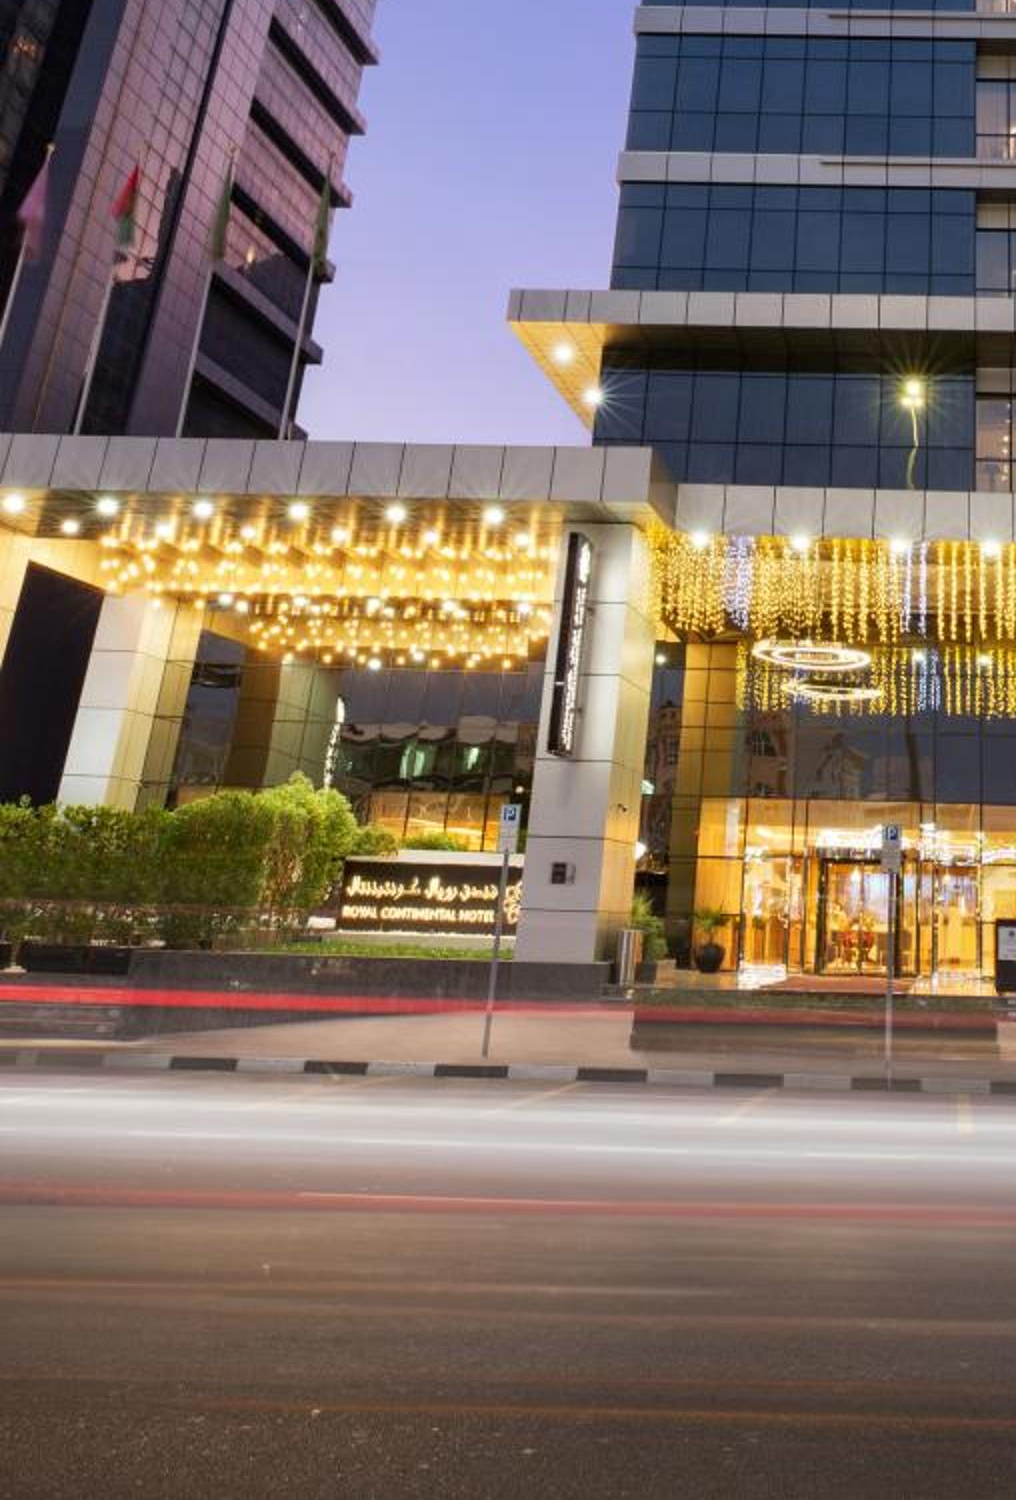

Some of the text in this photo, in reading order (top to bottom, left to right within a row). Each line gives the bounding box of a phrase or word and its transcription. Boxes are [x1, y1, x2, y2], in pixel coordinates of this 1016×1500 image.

[341, 905, 495, 924] ROYAL CONTINENTAL HOTEL
